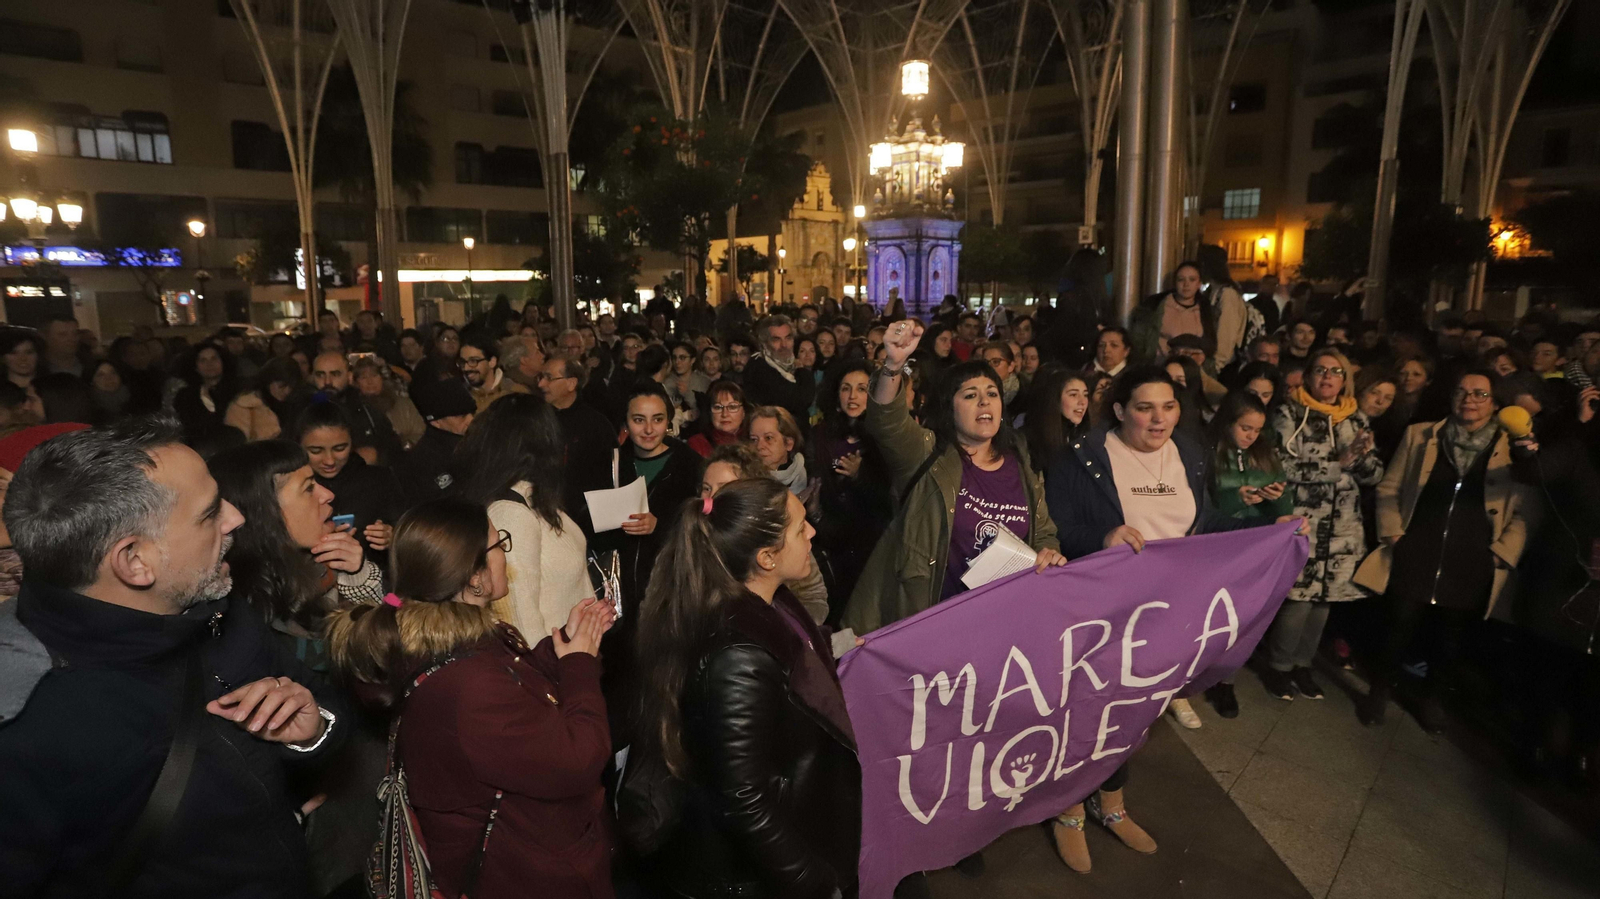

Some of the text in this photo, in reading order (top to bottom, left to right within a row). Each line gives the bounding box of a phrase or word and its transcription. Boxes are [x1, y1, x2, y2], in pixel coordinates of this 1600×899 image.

[969, 494, 999, 509] nostras
[1131, 485, 1176, 493] authetic
[908, 587, 1238, 751] MAREA
[895, 682, 1190, 825] VIOLET
